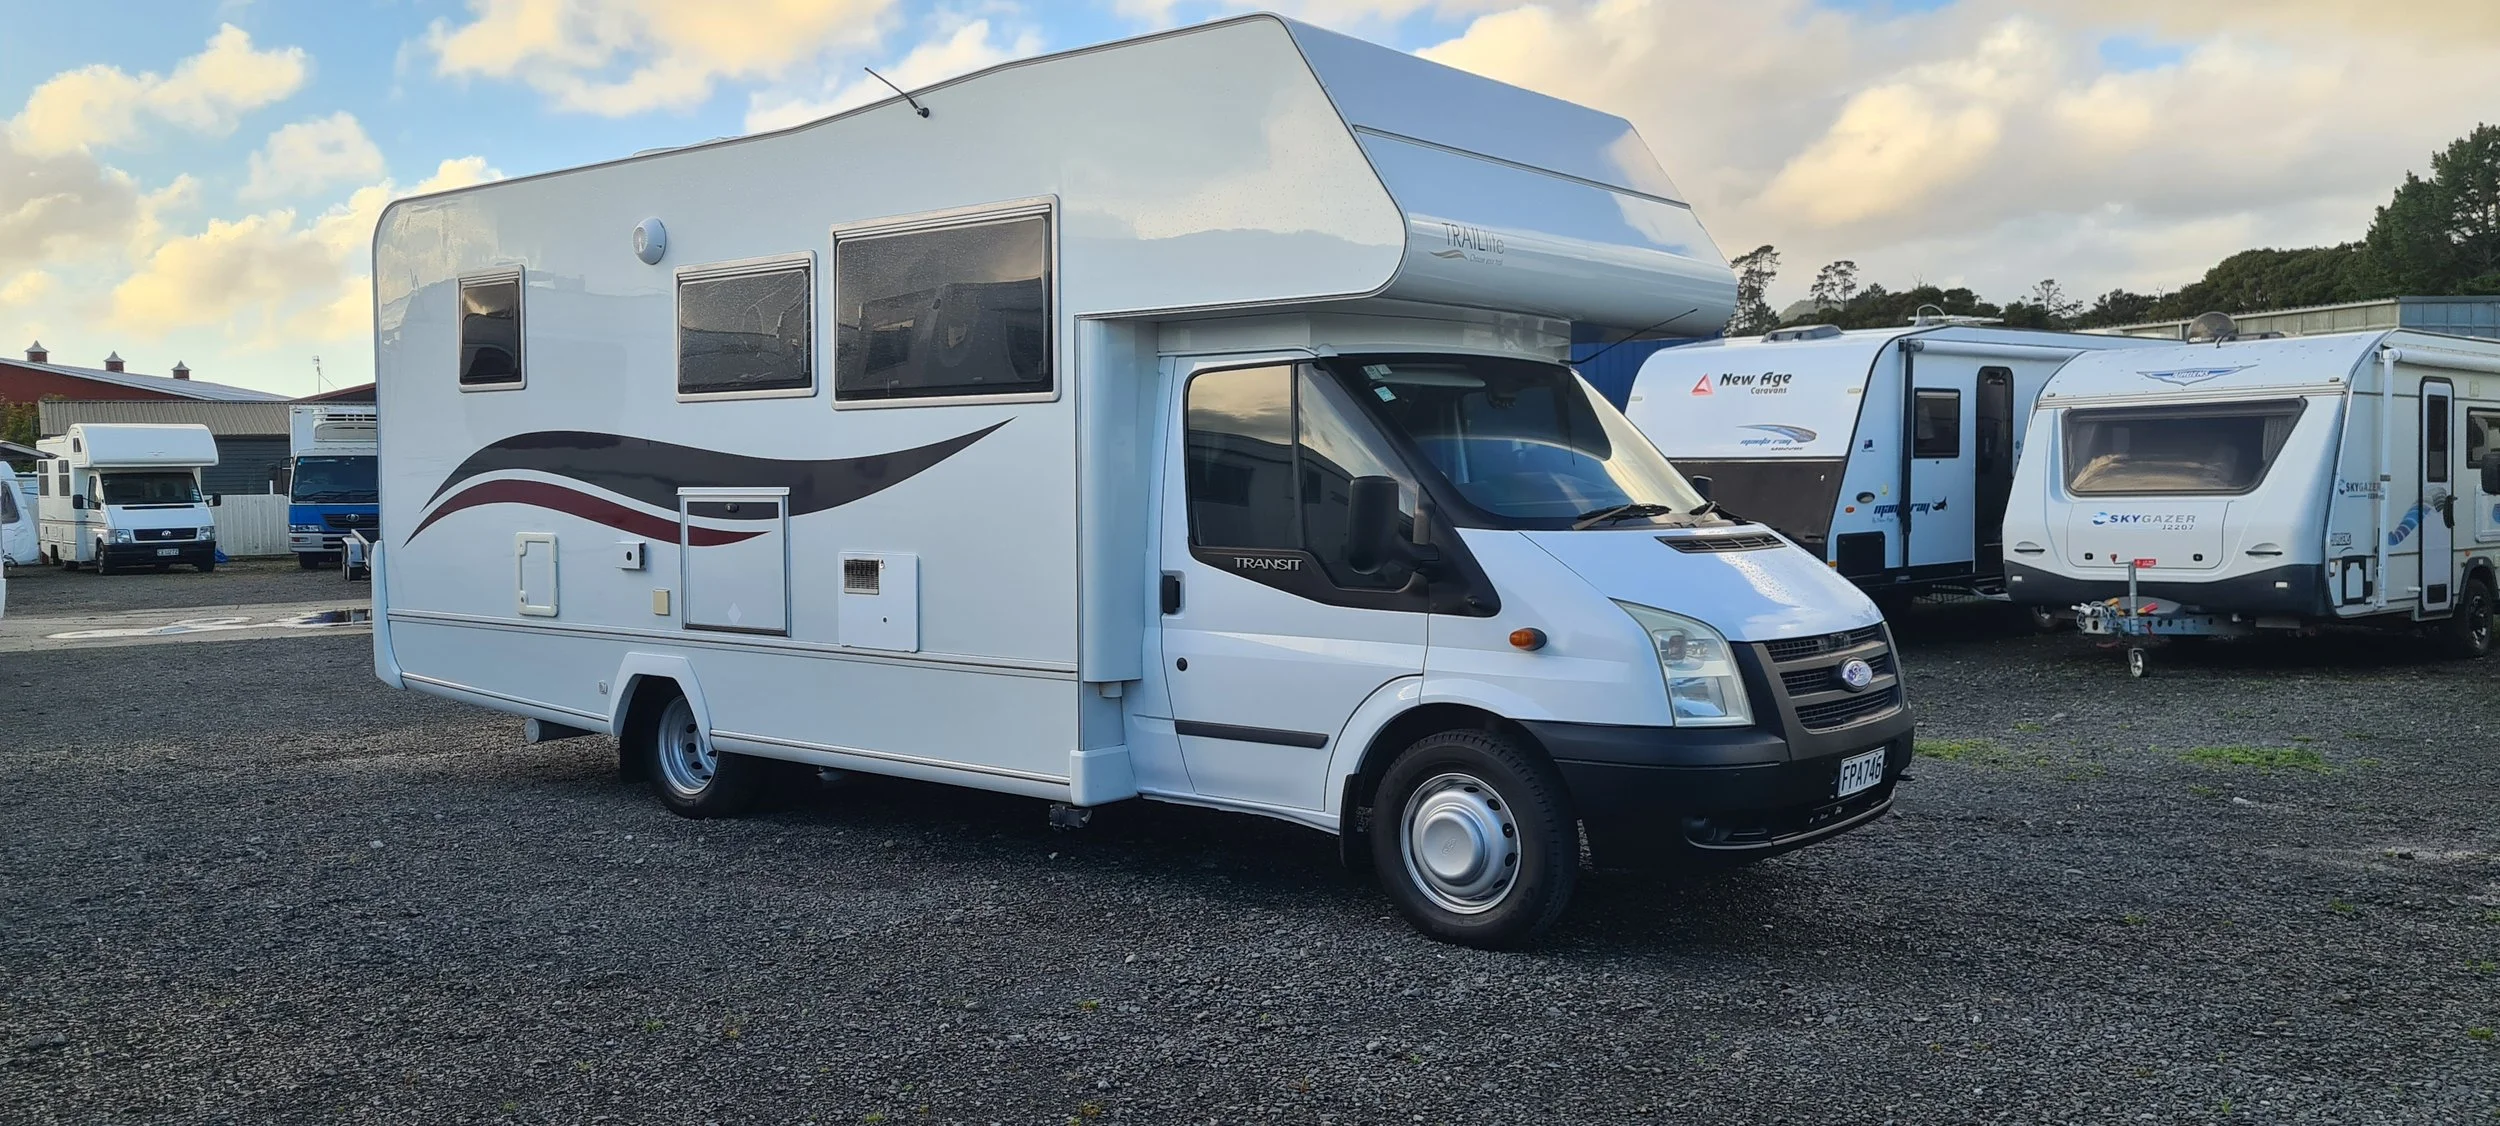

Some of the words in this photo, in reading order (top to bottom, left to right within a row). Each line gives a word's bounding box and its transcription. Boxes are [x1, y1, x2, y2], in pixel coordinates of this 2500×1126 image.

[1441, 222, 1505, 255] TRAILlite
[1719, 373, 1756, 386] New
[1760, 371, 1793, 388] Age
[1750, 386, 1788, 395] Caravans
[2109, 514, 2196, 524] SKYGAZER
[1233, 557, 1302, 571] TRANSIT
[1841, 754, 1883, 792] FPA746
